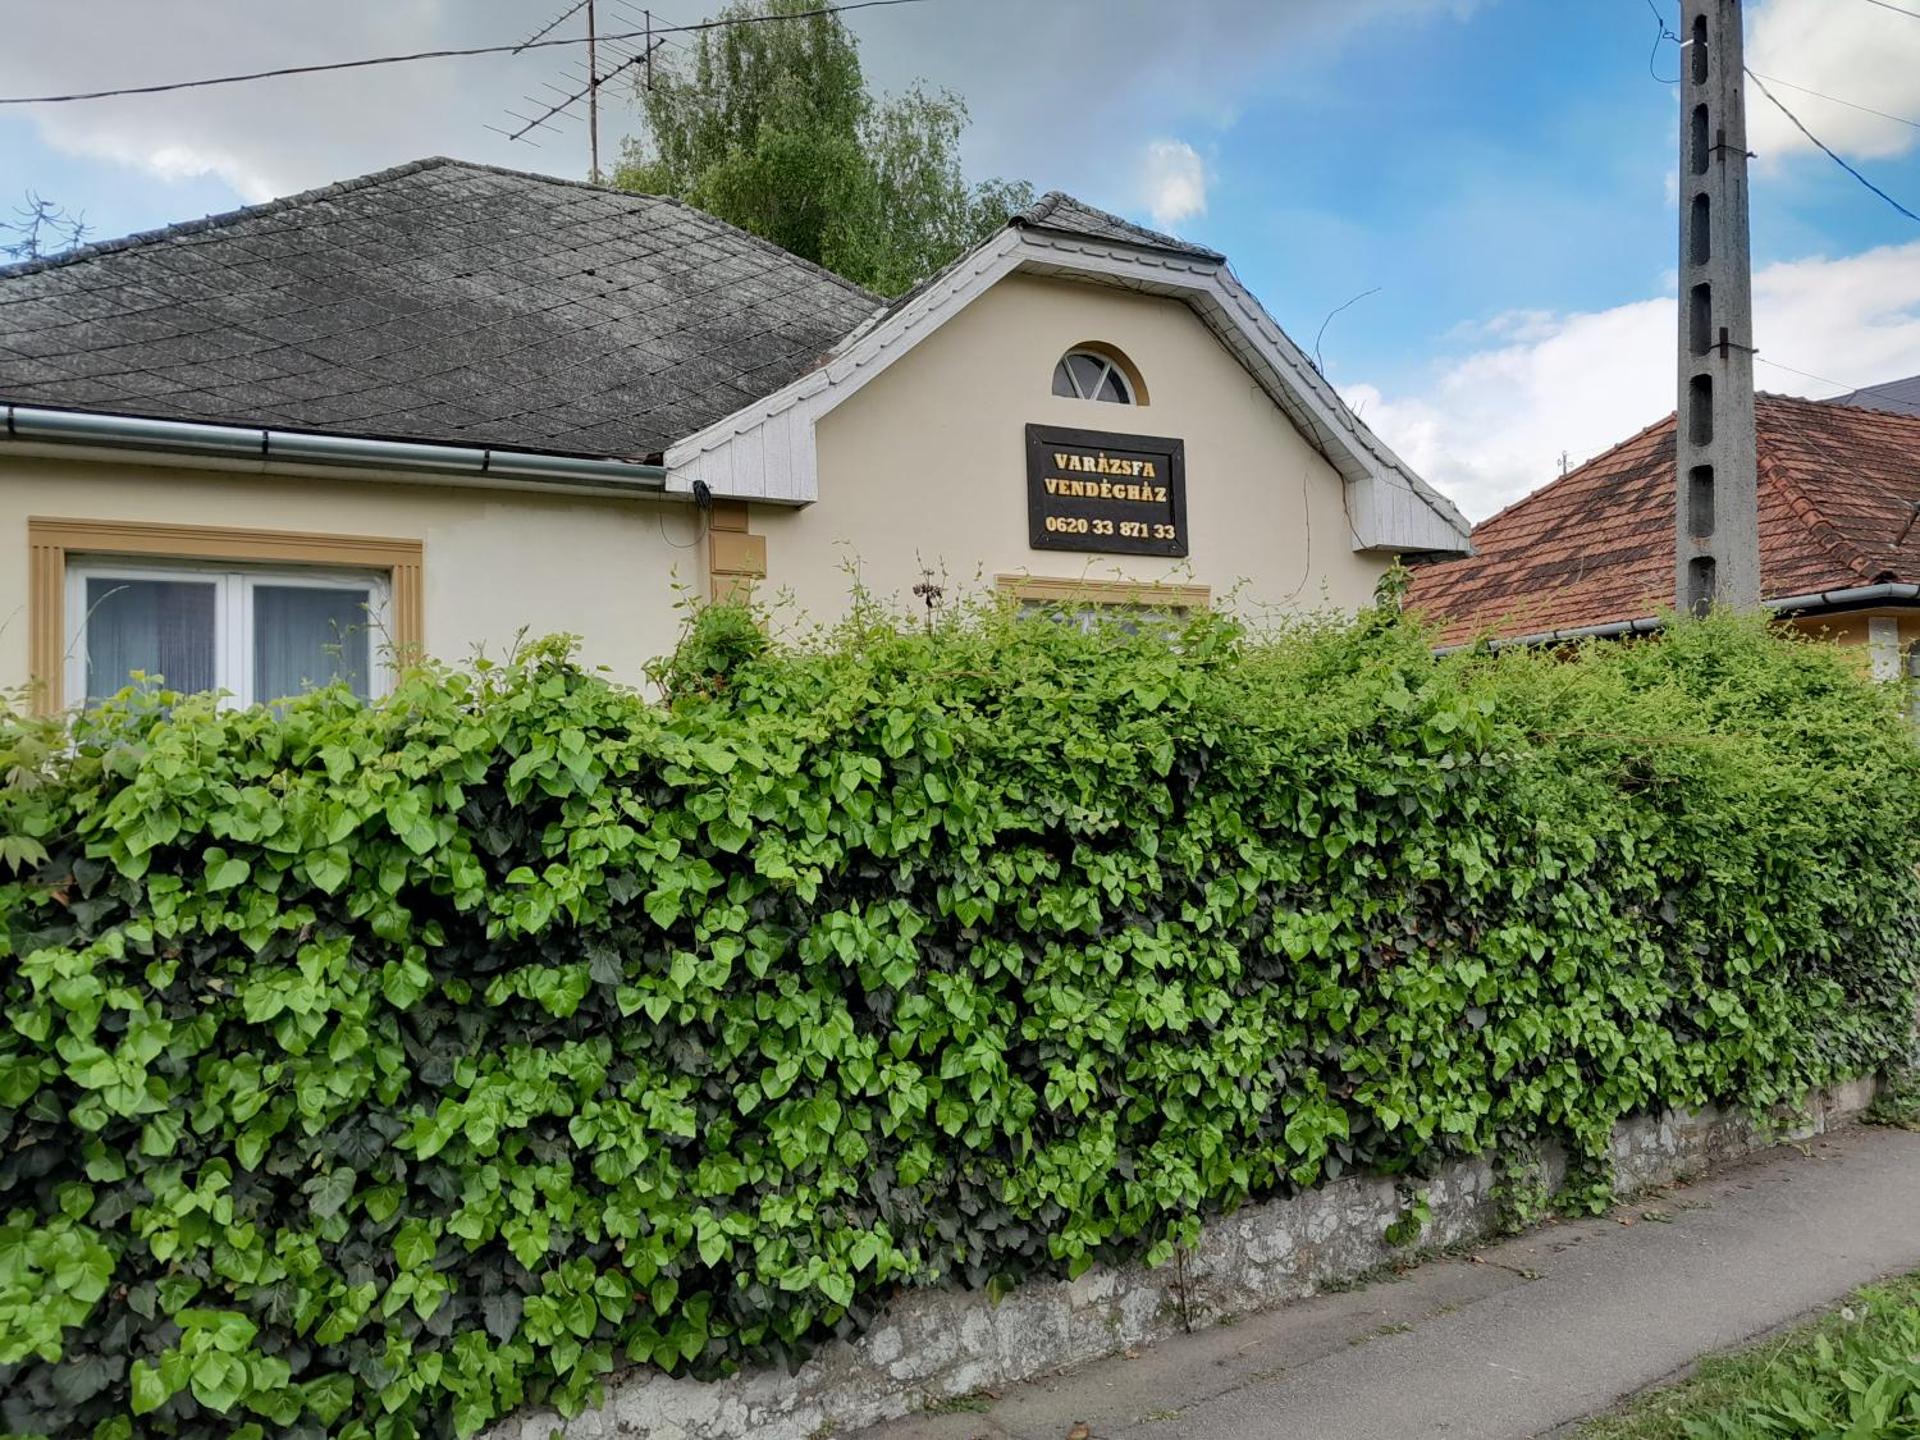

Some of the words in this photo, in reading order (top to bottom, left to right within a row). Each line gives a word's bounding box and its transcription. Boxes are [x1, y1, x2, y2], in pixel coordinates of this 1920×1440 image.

[1054, 452, 1155, 477] VARÁZSFA
[1044, 478, 1167, 502] VENDÉGHÁZ
[1046, 517, 1088, 534] 0620
[1092, 520, 1113, 535] 33
[1120, 522, 1149, 537] 871
[1153, 524, 1175, 540] 33
